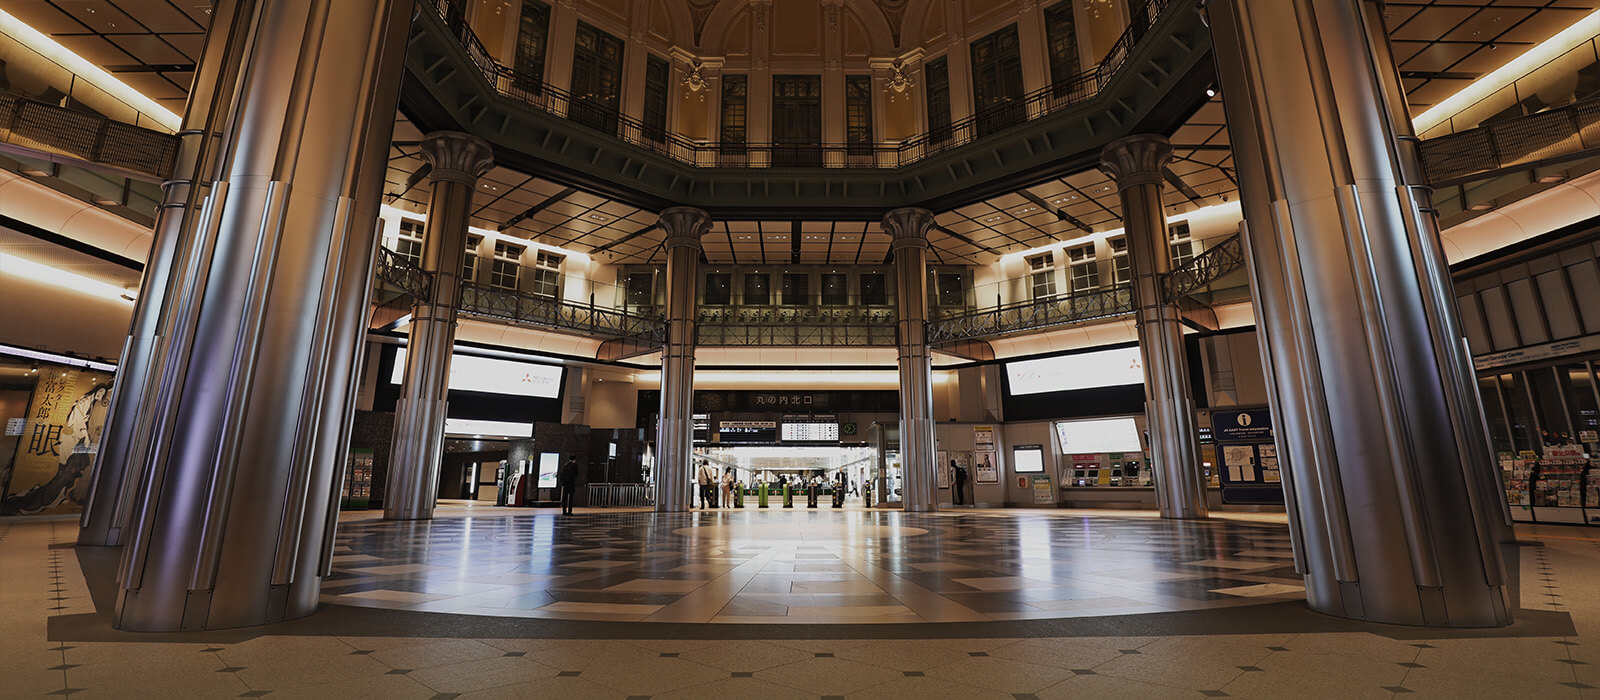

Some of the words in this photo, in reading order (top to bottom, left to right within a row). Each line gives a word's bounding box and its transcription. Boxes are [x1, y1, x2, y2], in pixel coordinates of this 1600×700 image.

[756, 395, 812, 405] 丸の内北口
[28, 424, 63, 456] 眼
